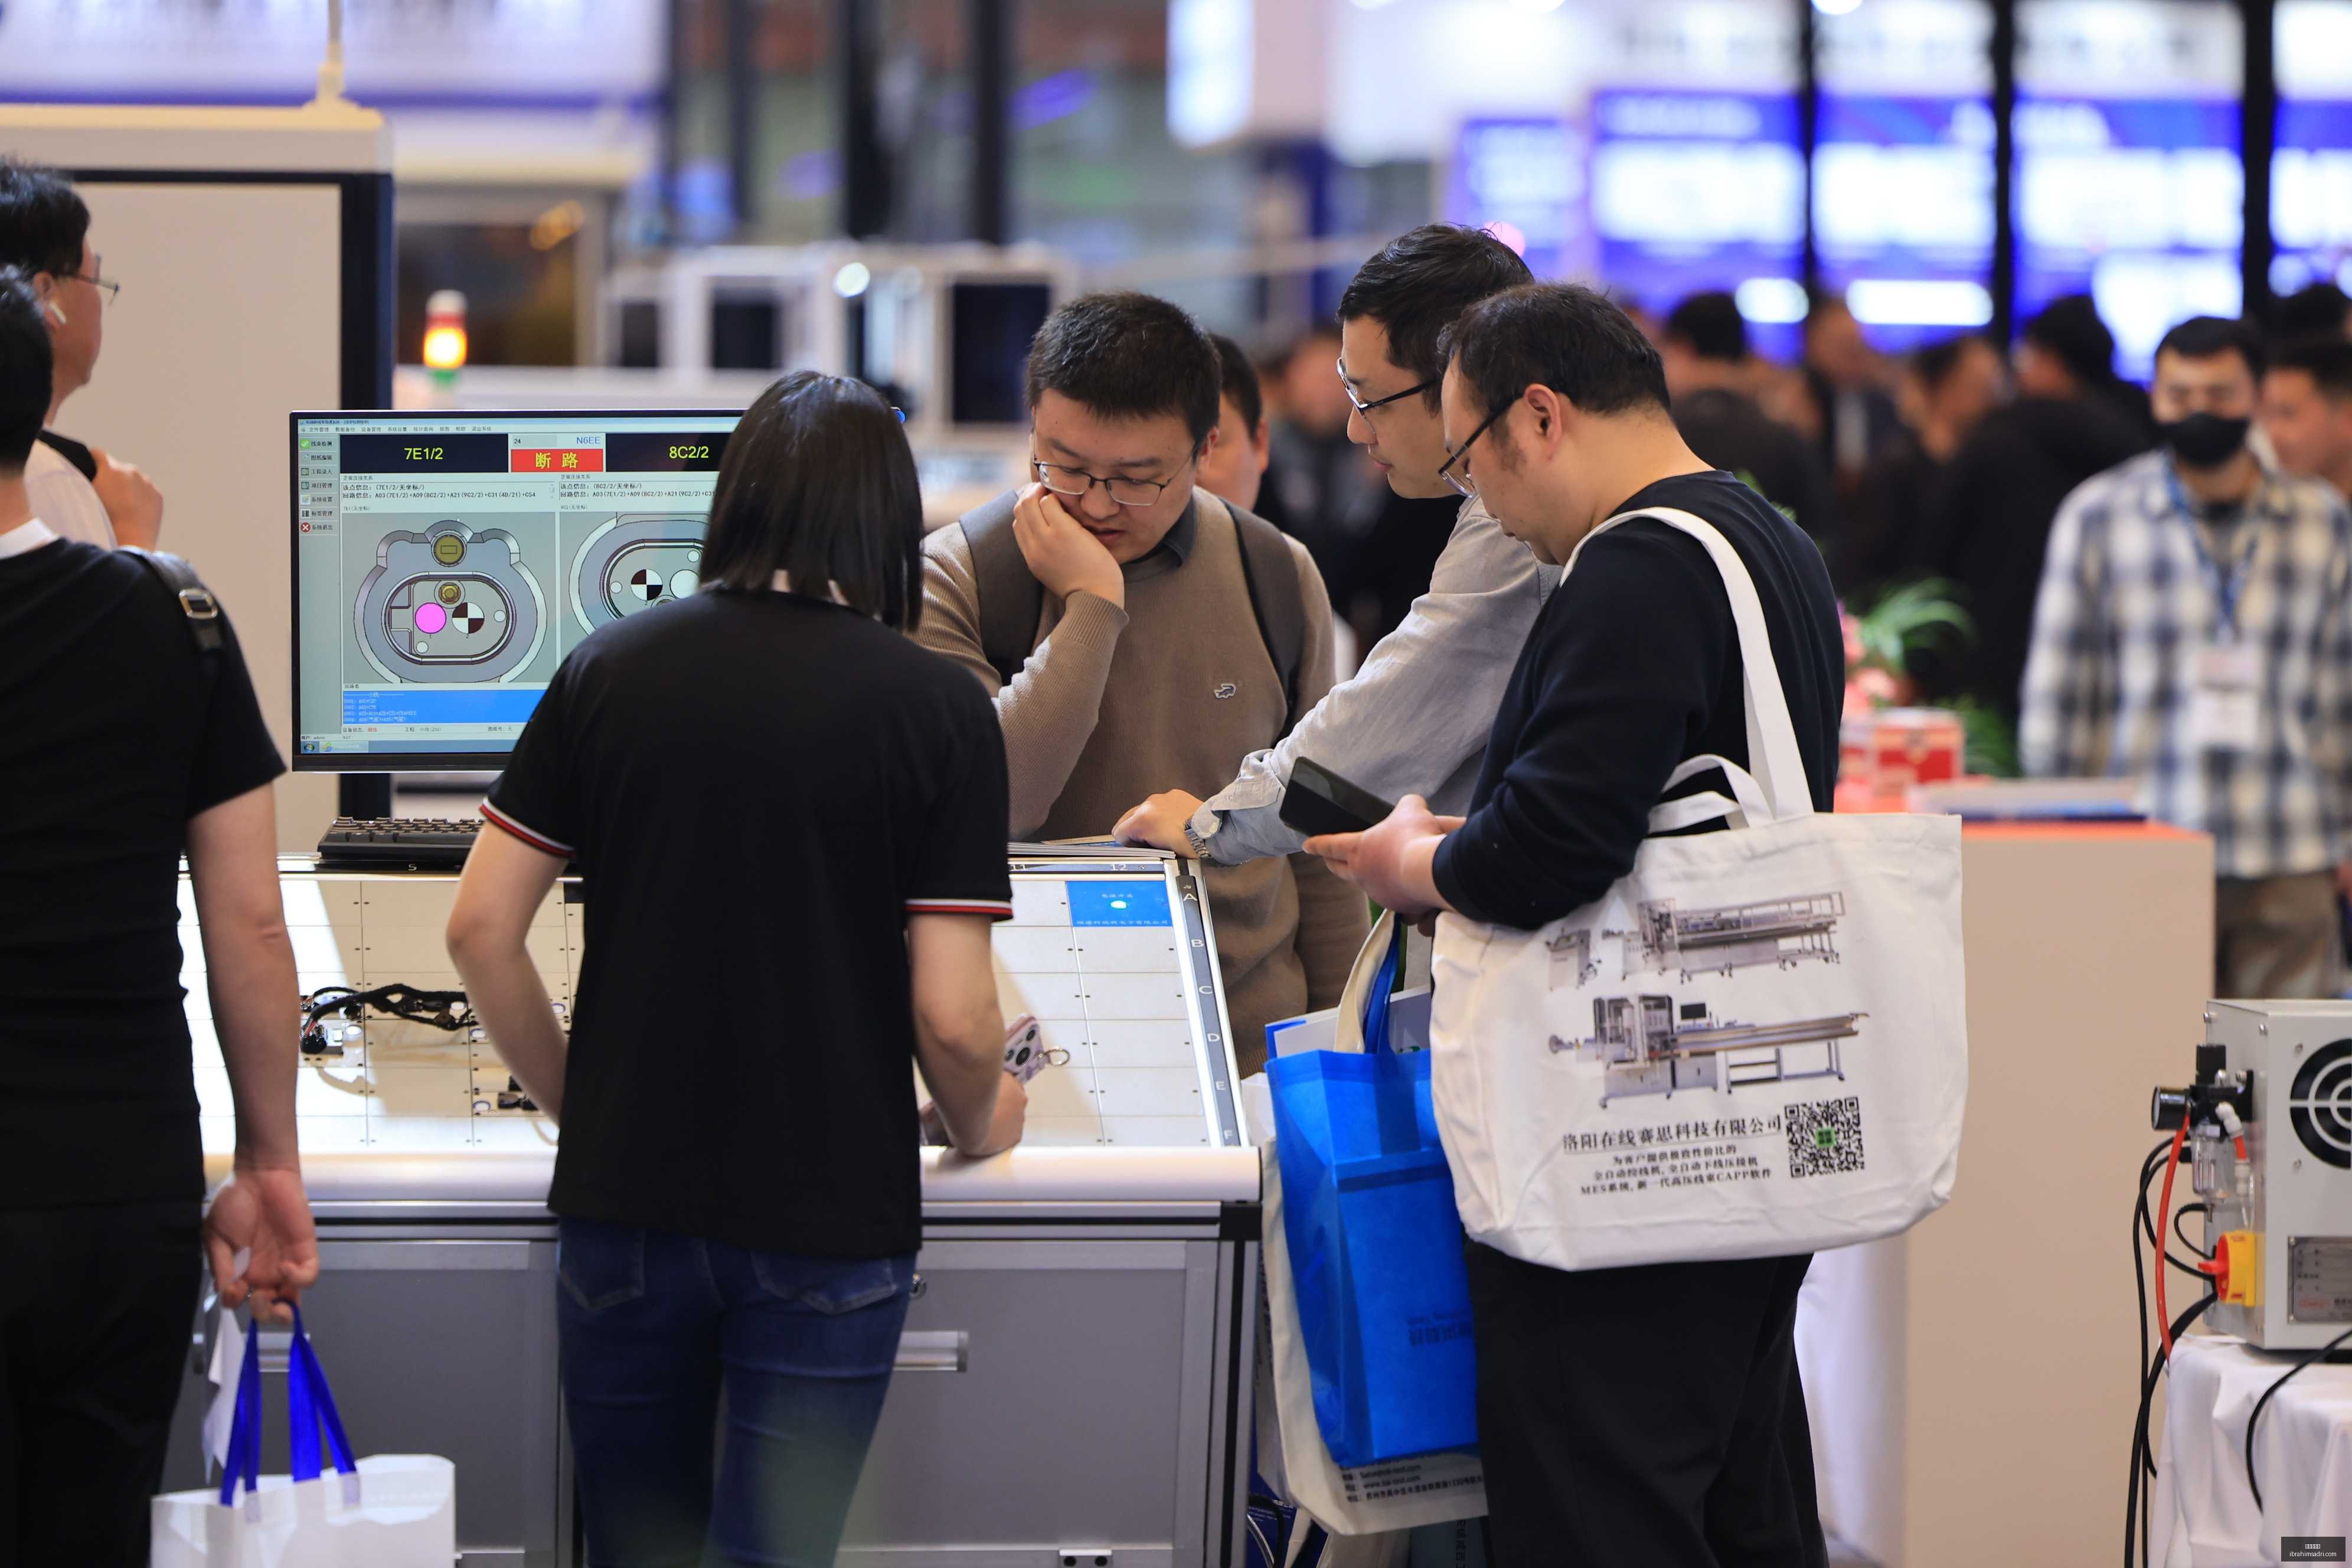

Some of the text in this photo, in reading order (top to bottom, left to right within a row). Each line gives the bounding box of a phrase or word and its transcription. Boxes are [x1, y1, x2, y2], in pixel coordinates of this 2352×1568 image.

[576, 436, 600, 445] N6EE
[404, 447, 443, 460] 7E1/2
[669, 446, 709, 459] 8C2/2
[535, 452, 578, 469] 断路
[1183, 893, 1197, 901] A
[1191, 939, 1204, 948] B
[1199, 985, 1213, 994] C
[1207, 1034, 1220, 1043] D
[1215, 1081, 1226, 1091] E
[1223, 1130, 1233, 1140] F
[1563, 1115, 1781, 1149] 洛阳在线赛思科技有限公司
